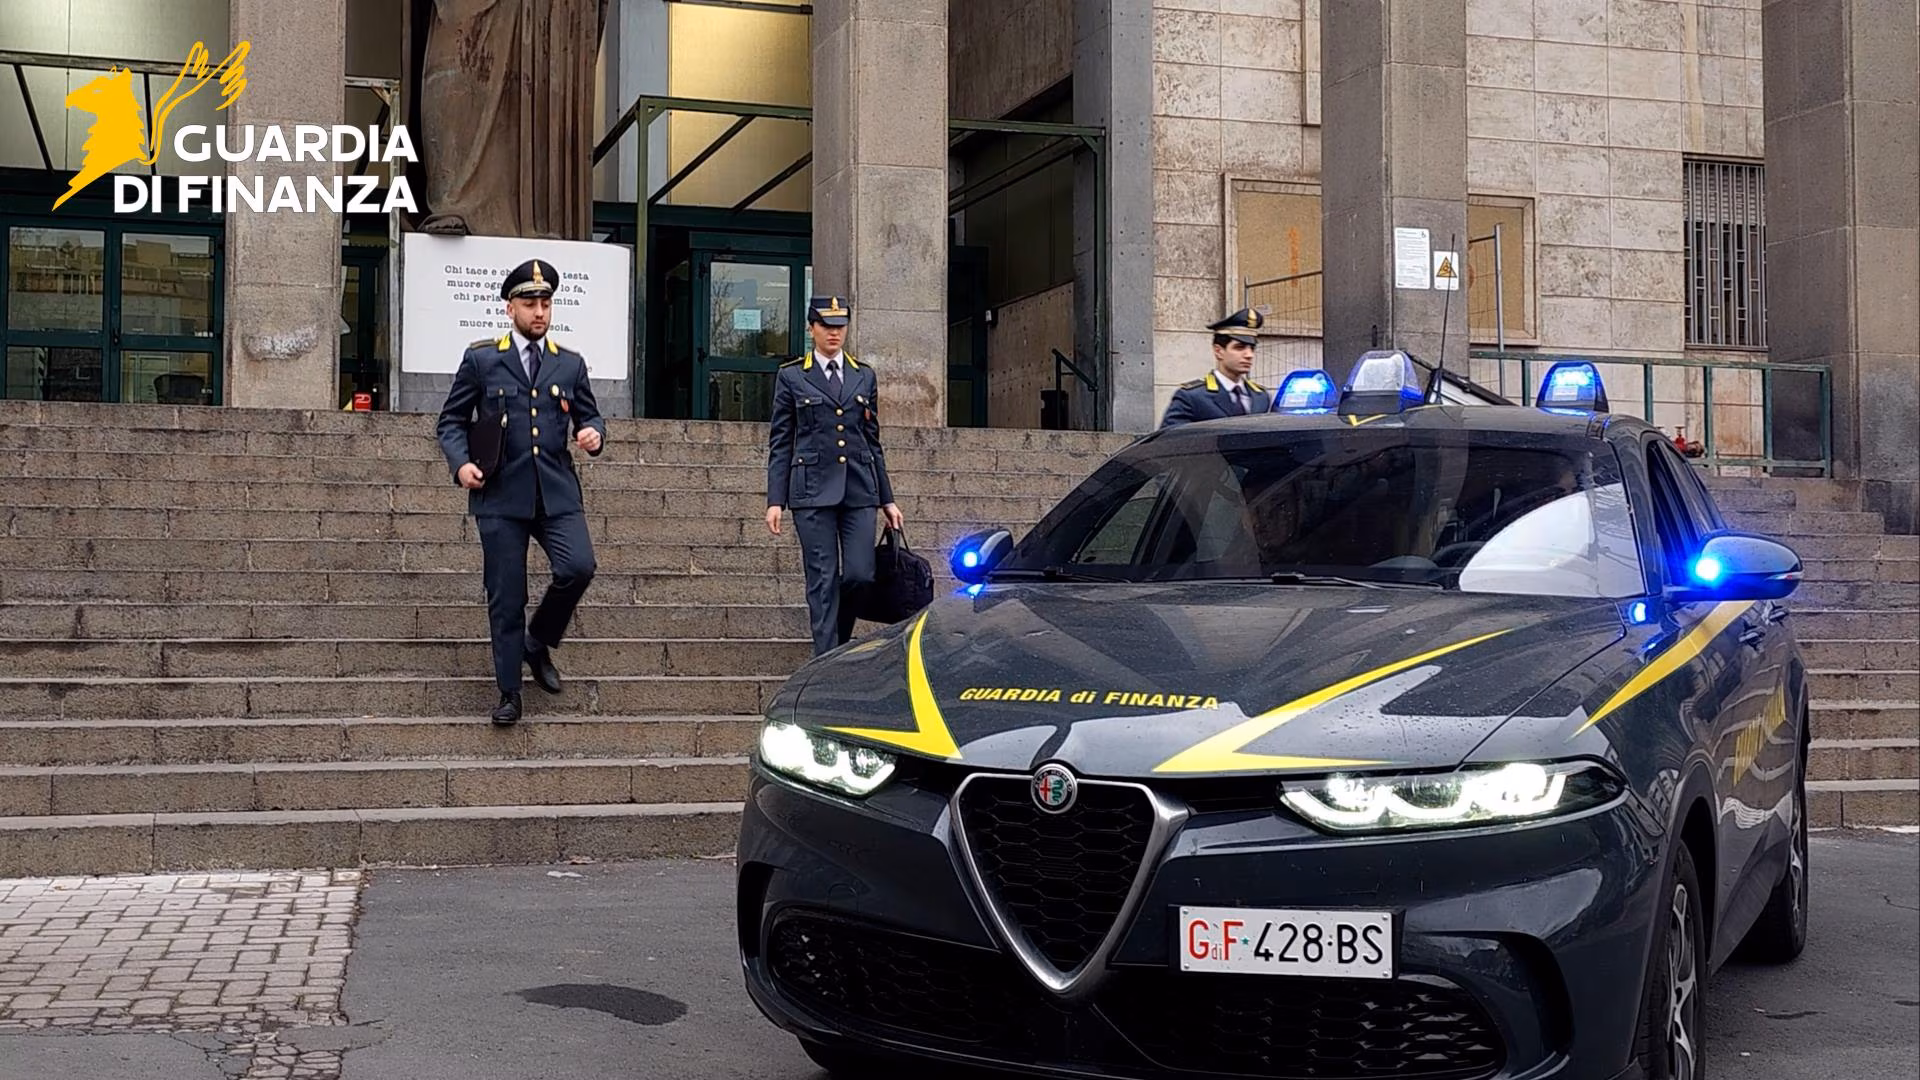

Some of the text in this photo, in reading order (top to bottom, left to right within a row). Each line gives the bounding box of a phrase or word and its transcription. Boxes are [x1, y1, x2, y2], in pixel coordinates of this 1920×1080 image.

[444, 265, 462, 275] Chi
[465, 267, 489, 276] tace
[500, 269, 512, 277] ch
[562, 272, 589, 281] testa
[447, 280, 587, 295] muore ogn lo fa,
[453, 292, 580, 306] chi parla mina
[459, 320, 494, 329] muore
[959, 687, 1220, 710] GUARDIA di FINANZA
